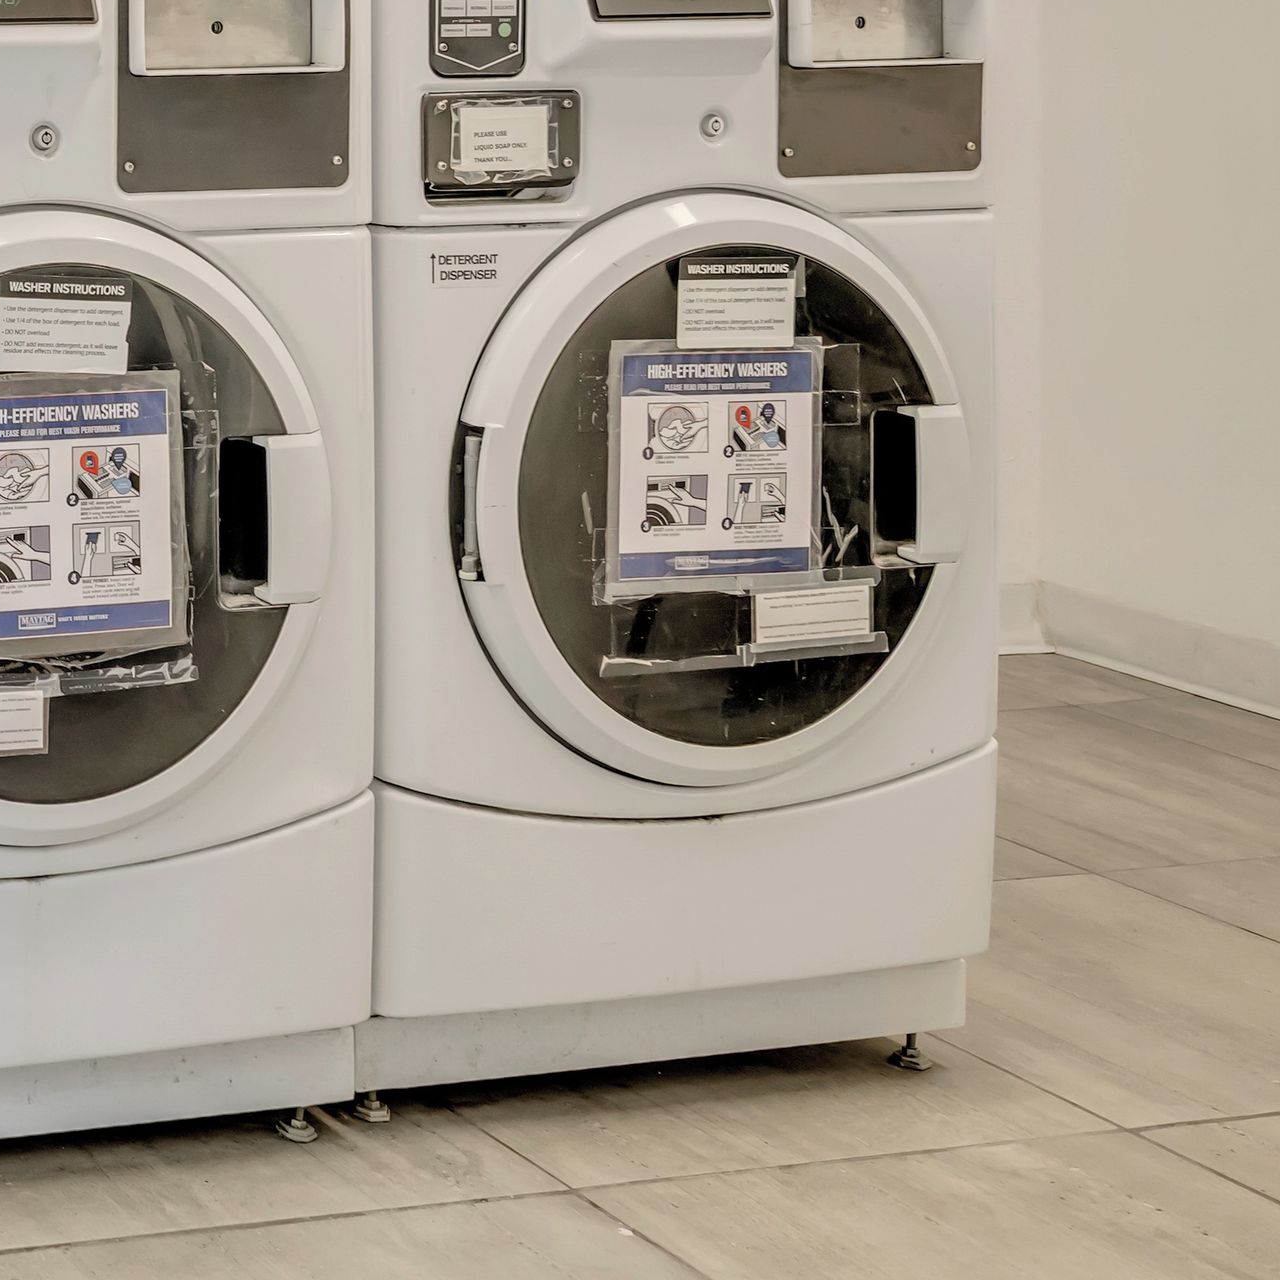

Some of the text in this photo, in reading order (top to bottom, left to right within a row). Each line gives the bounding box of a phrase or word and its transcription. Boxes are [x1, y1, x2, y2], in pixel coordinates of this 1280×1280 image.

[438, 254, 498, 265] DETERGENT
[440, 270, 497, 281] DISPENSER
[687, 264, 789, 275] WASHER INSTRUCTIONS
[9, 281, 125, 295] WASHER INSTRUCTIONS
[647, 362, 788, 380] HIGH-EFFICIENCY WASHERS
[82, 402, 140, 420] WASHERS
